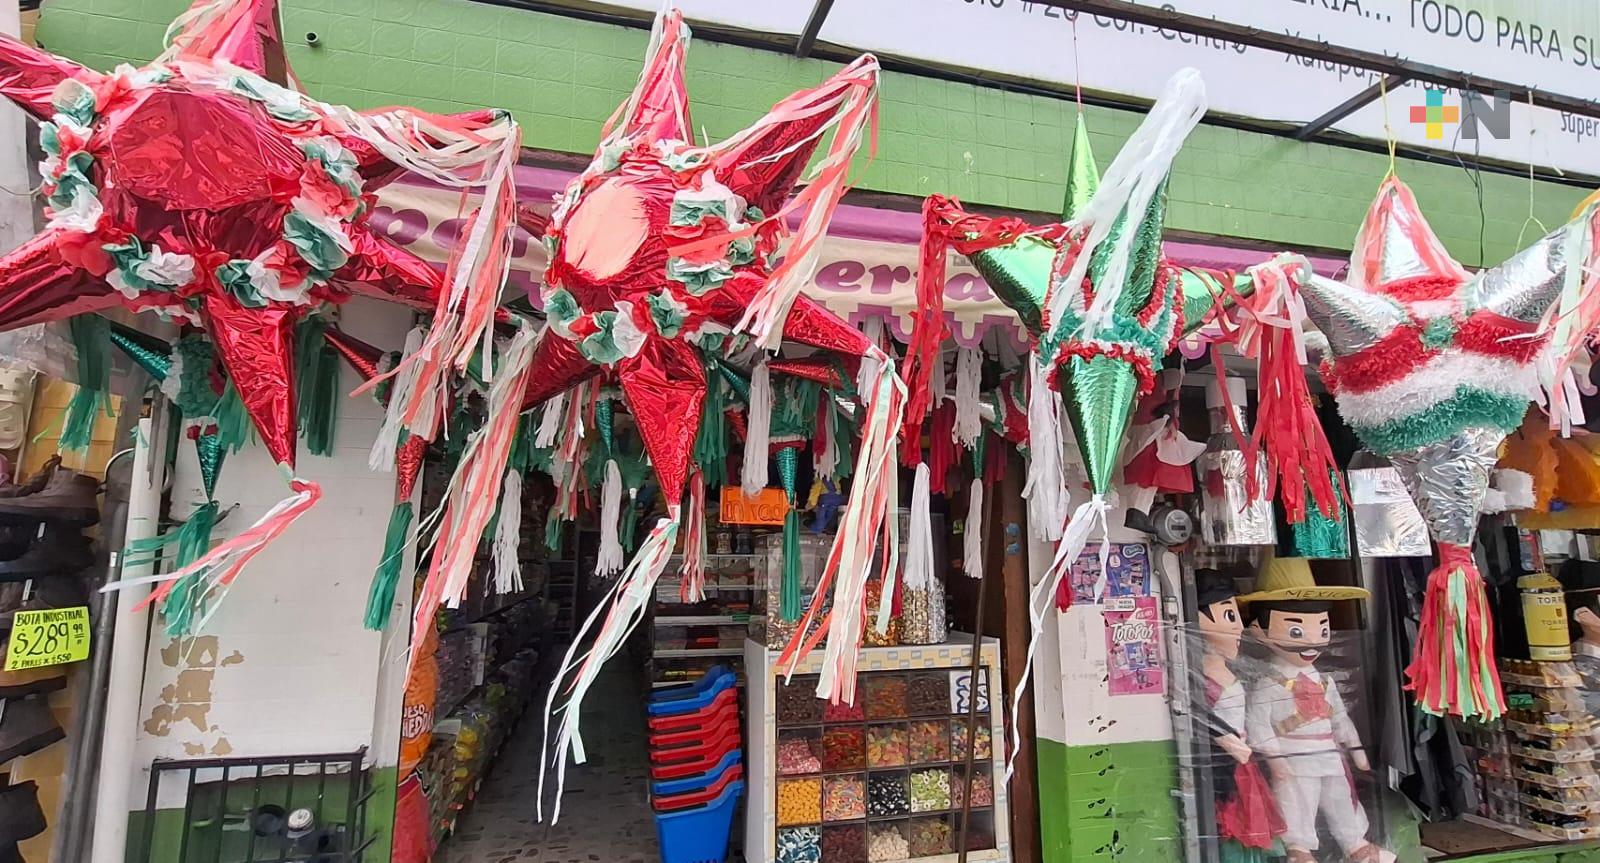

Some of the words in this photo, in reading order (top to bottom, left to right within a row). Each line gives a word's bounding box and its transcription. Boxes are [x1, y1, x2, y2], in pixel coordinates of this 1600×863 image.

[1408, 0, 1484, 43] TODO
[1496, 16, 1563, 61] PARA
[16, 613, 40, 627] BOTA
[43, 609, 84, 623] INDUSTRIAL
[14, 622, 69, 658] $289
